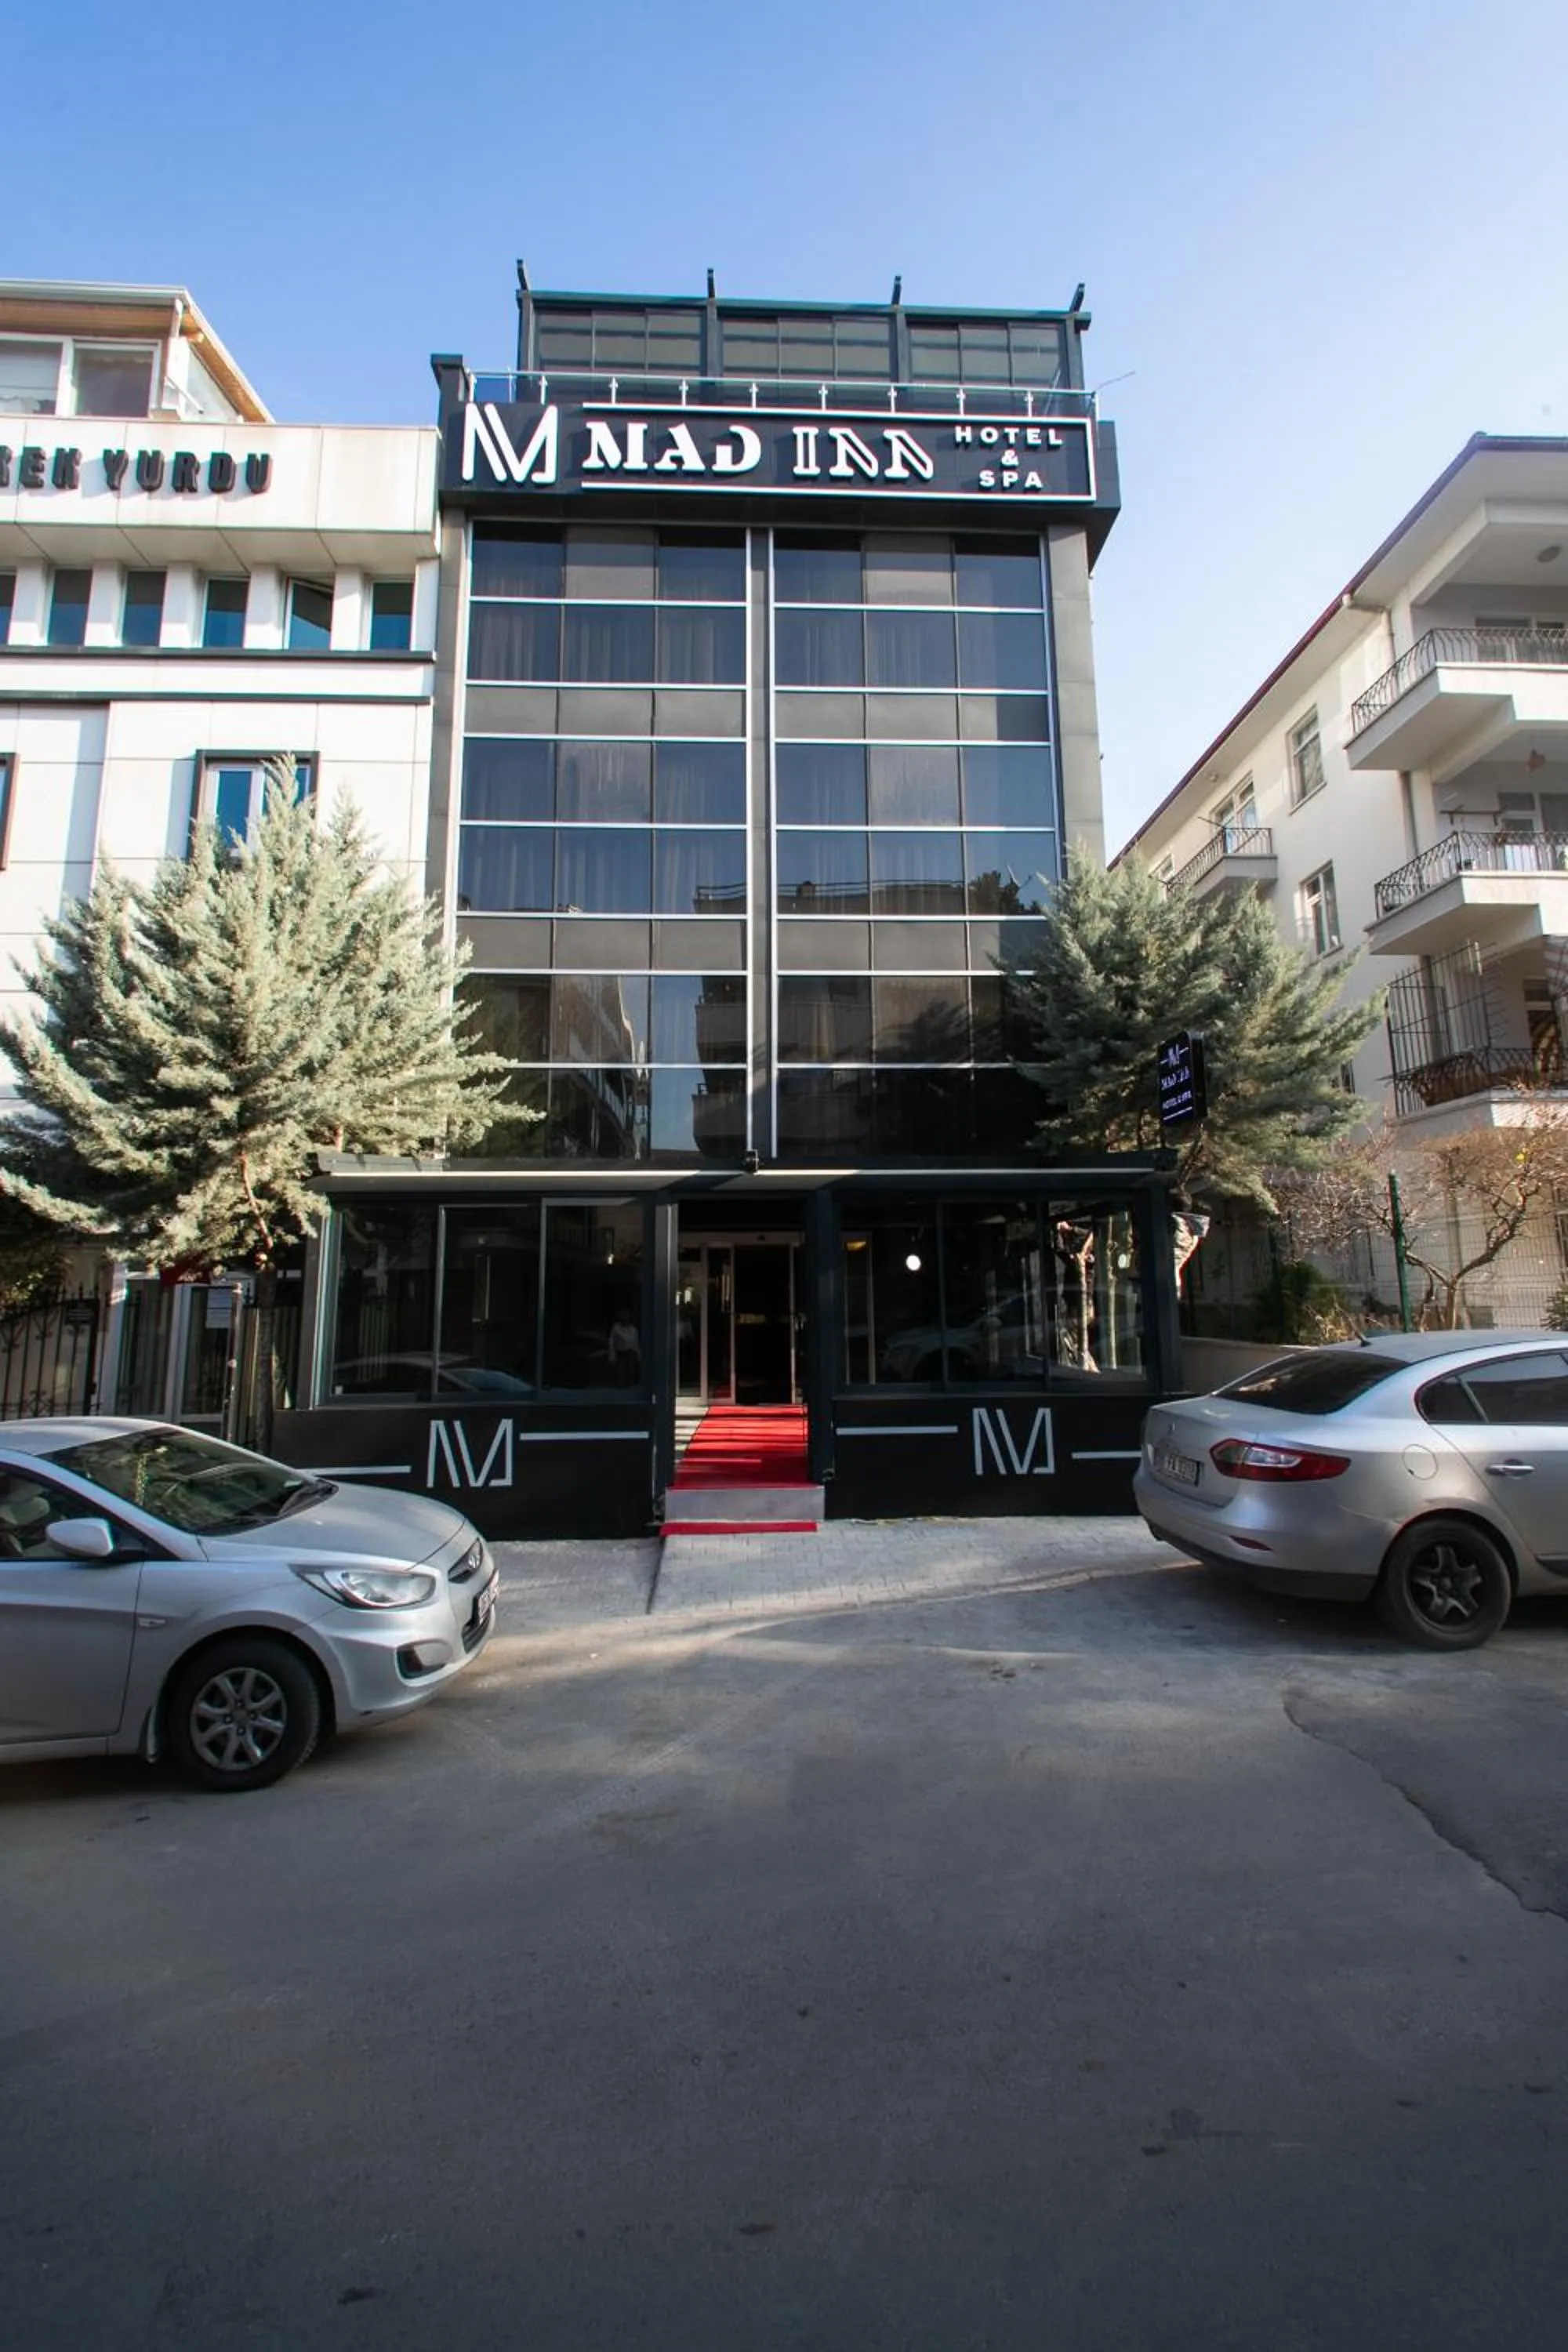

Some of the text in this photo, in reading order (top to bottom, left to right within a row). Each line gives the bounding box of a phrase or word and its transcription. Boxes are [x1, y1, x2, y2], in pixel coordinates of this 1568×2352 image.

[956, 426, 1063, 445] HOTEL
[582, 421, 934, 479] MAD INN
[1001, 448, 1019, 466] &
[102, 449, 273, 494] YURDU
[979, 470, 1044, 488] SPA
